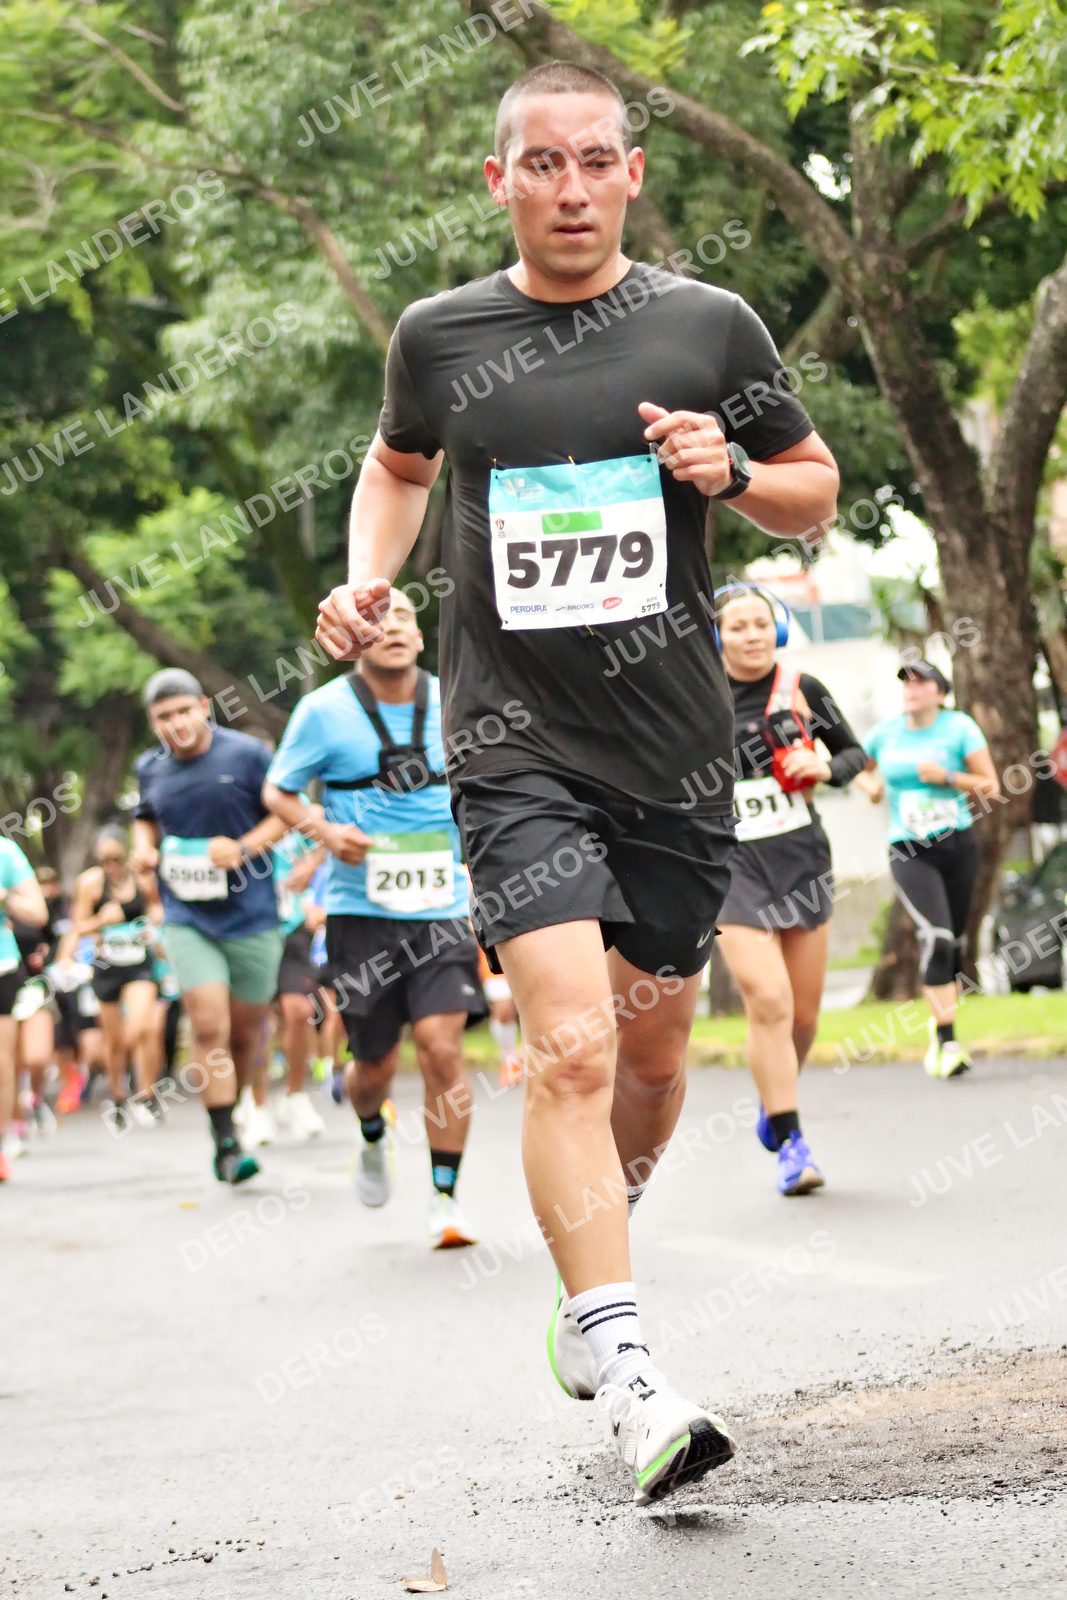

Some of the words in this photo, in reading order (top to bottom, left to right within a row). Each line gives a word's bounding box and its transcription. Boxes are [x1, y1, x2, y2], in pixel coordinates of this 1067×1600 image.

[507, 531, 654, 589] 5779
[510, 604, 547, 614] PERDURA
[567, 602, 595, 611] BROOKS
[641, 602, 661, 613] 5779
[375, 867, 447, 891] 2013
